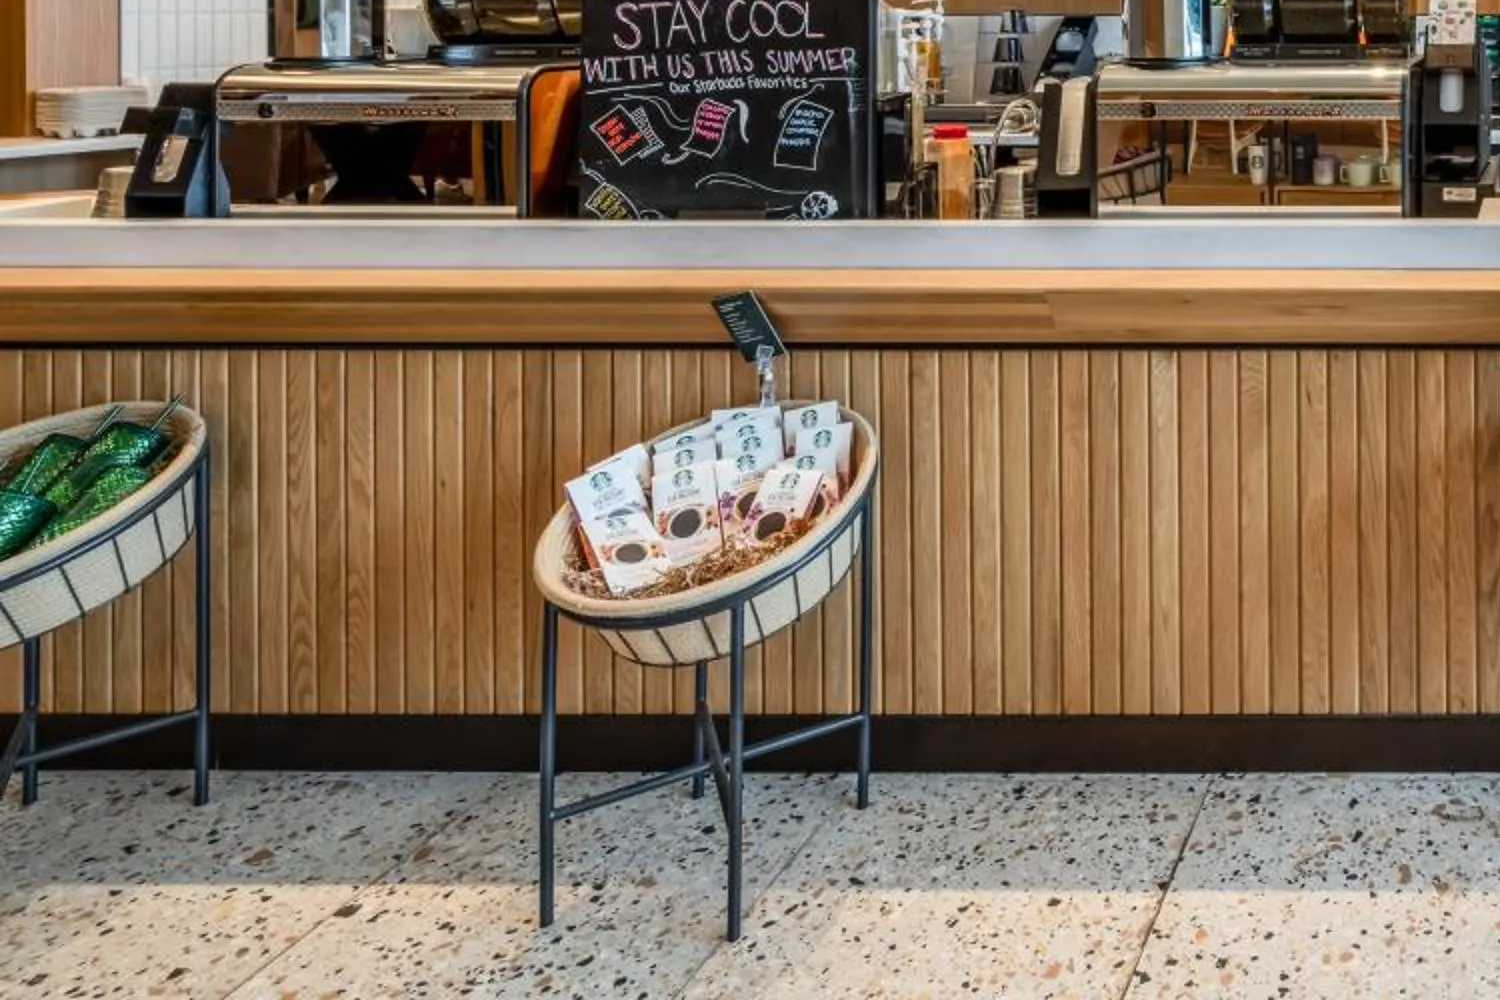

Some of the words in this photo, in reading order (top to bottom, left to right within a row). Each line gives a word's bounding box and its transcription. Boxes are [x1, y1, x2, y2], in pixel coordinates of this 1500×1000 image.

[613, 0, 711, 49] STAY
[725, 0, 826, 43] COOL
[583, 54, 658, 84] WITH
[667, 53, 696, 79] US
[700, 50, 754, 76] THIS
[765, 47, 859, 74] SUMMER
[748, 77, 808, 91] Favorites
